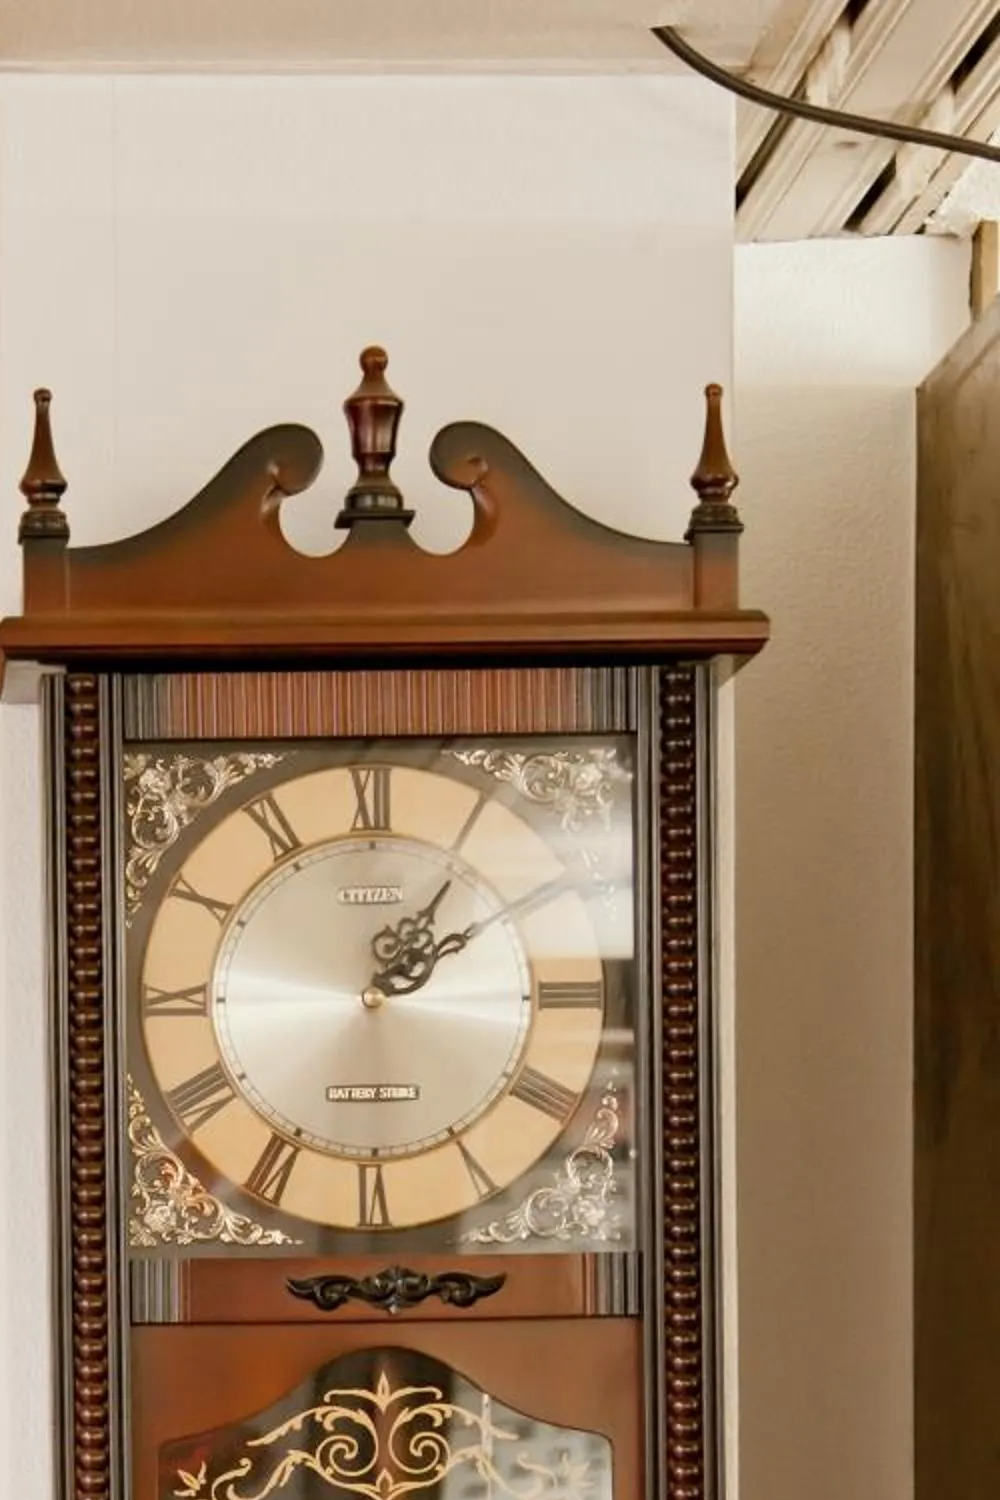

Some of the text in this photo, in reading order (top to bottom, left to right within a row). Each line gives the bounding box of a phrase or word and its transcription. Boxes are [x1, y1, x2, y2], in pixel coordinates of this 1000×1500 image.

[243, 794, 302, 863] XI
[349, 767, 392, 832] XII
[168, 873, 234, 925] X
[142, 982, 208, 1018] IX
[538, 981, 602, 1010] III
[163, 1061, 238, 1135] VIII
[242, 1132, 300, 1206] VII
[357, 1163, 393, 1228] VI
[456, 1140, 502, 1199] V
